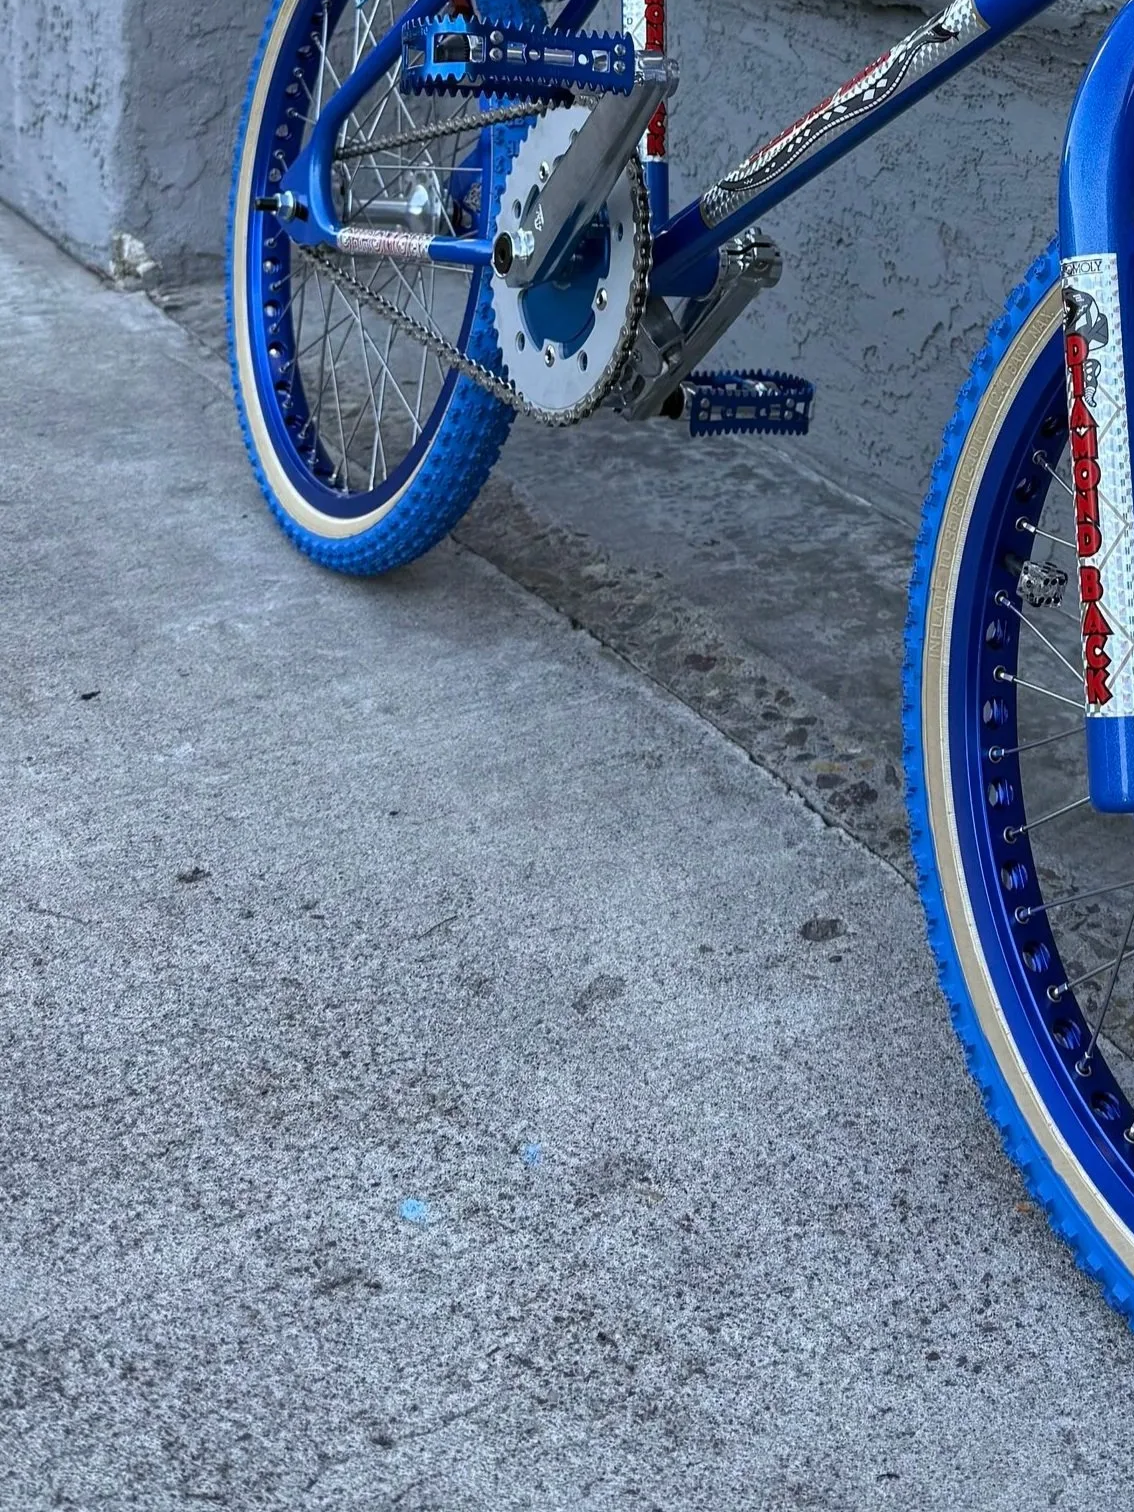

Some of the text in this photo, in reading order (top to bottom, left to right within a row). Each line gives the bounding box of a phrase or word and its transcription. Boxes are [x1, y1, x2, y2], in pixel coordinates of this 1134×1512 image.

[942, 518, 959, 545] 35
[1064, 332, 1114, 706] DIAMOND BACK
[940, 548, 951, 571] TO
[928, 579, 950, 660] INFLATE
